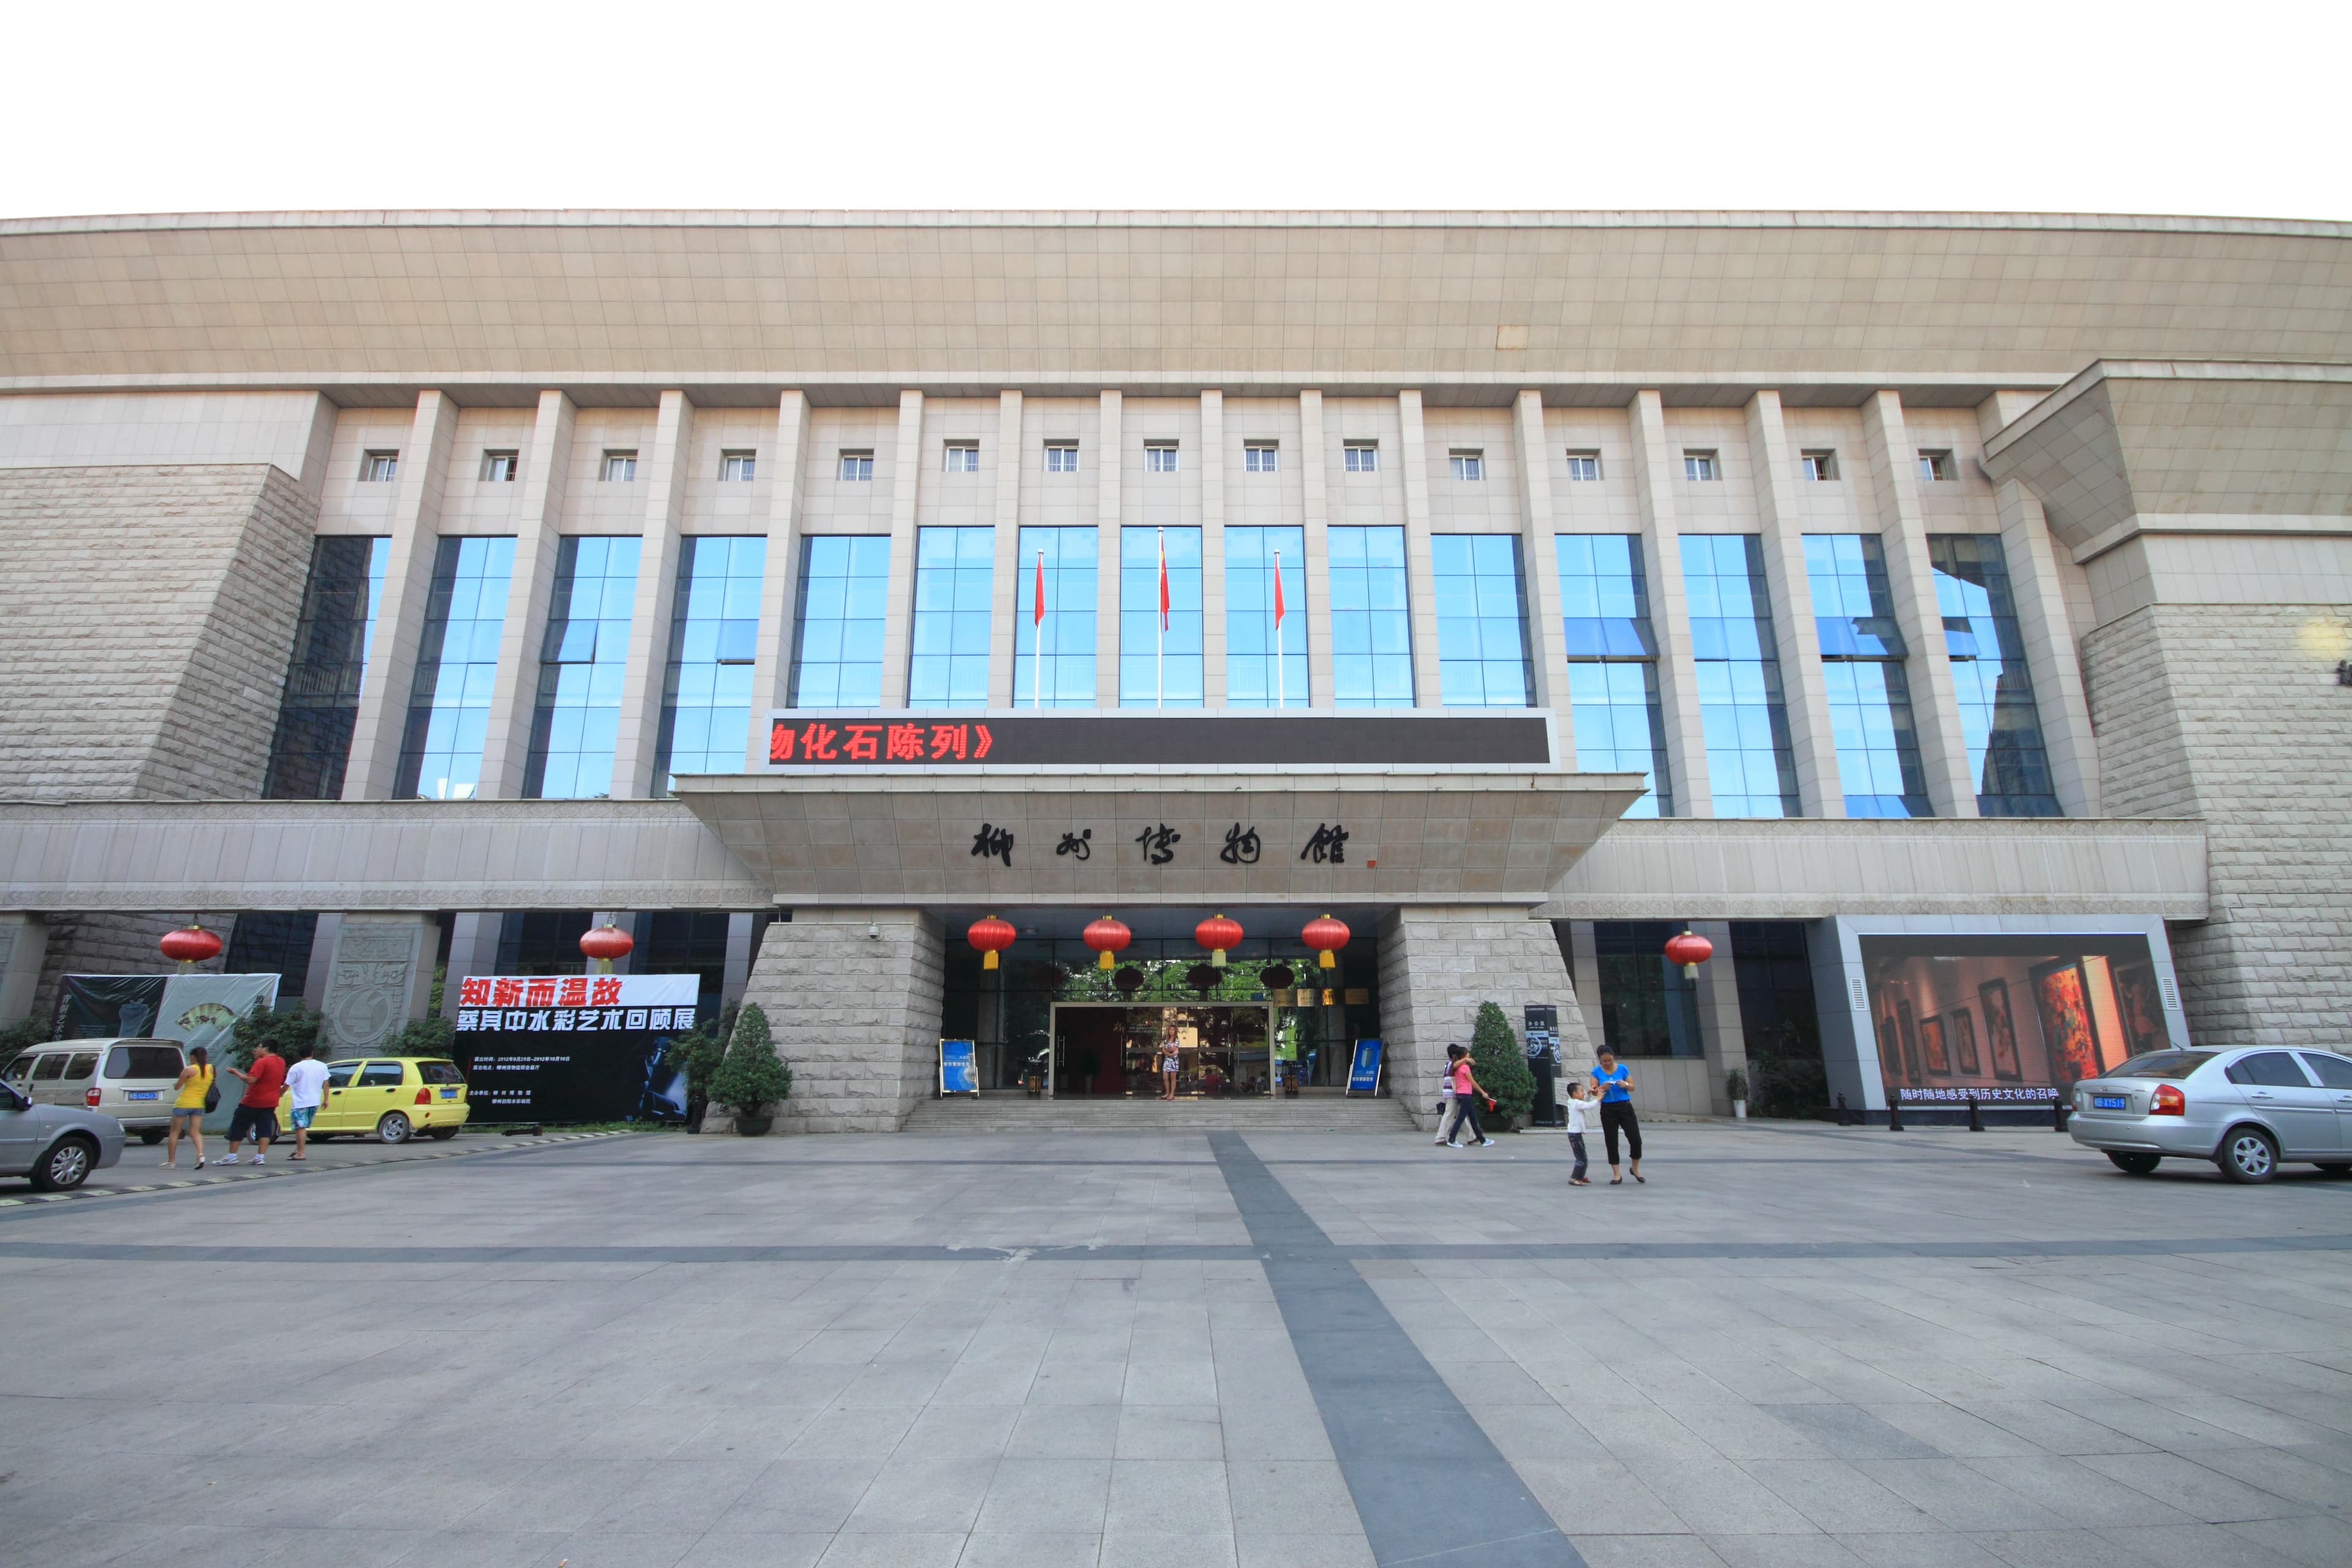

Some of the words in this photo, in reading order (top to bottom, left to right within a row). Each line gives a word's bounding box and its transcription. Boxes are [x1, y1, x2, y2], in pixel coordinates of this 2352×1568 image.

[459, 977, 622, 1007] 知新而温故
[456, 1008, 696, 1031] 蔡其中水彩艺术回顾展
[1900, 1088, 2059, 1101] 随时随地感受到历史文化的召唤
